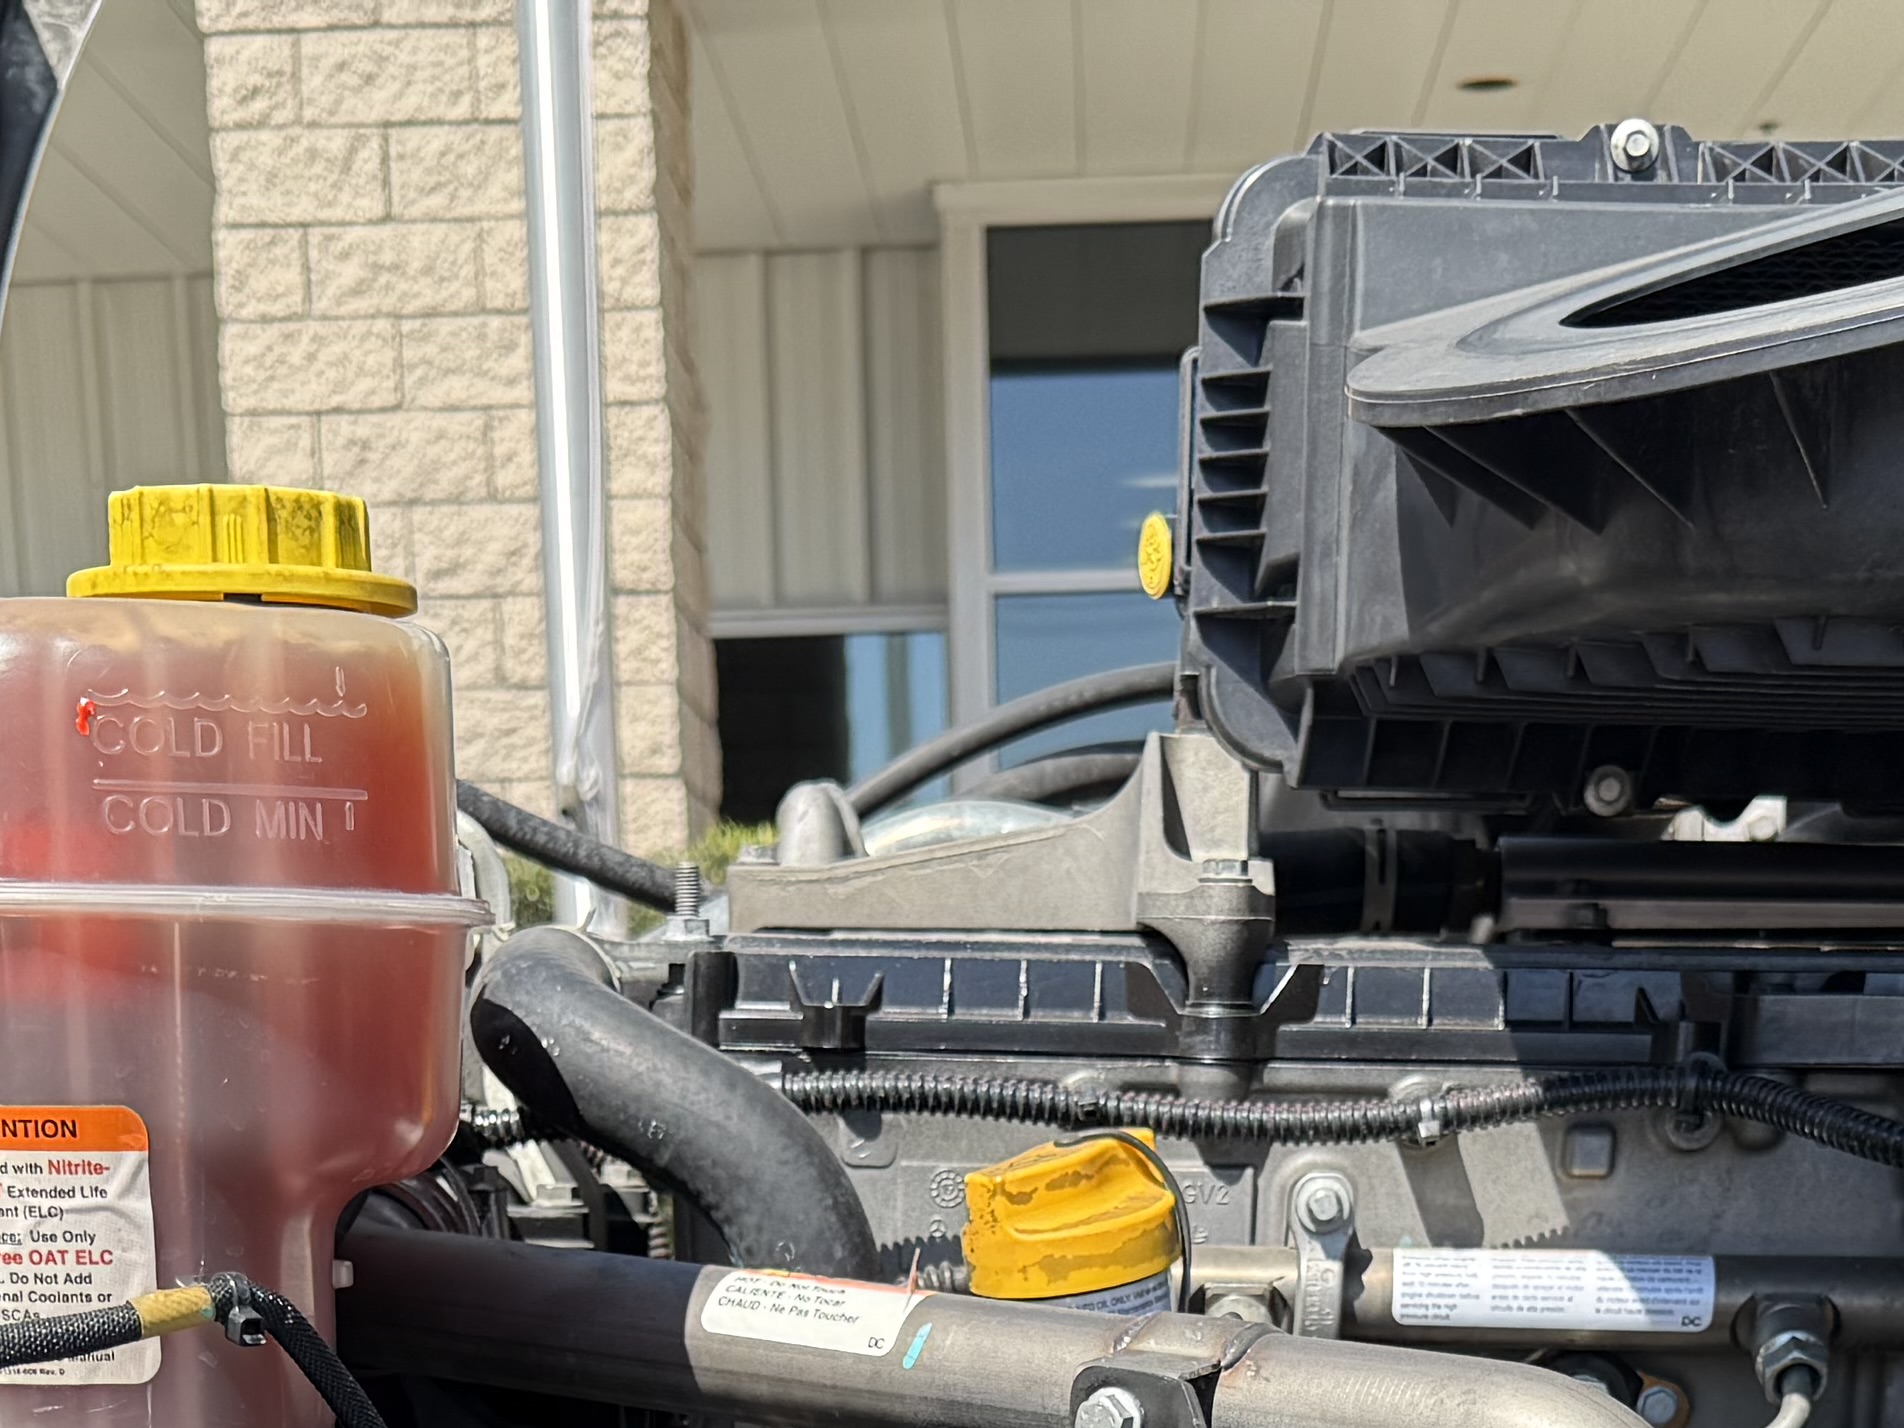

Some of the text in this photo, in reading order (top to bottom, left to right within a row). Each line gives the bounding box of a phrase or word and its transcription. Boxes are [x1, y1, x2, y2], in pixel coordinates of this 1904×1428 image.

[93, 715, 322, 763] COLD FILL
[101, 794, 324, 841] COLD MIN
[13, 1161, 43, 1175] with
[48, 1160, 110, 1175] Nitrite-
[7, 1185, 76, 1199] Extended
[80, 1185, 108, 1199] Life
[23, 1205, 64, 1221] (ELC)
[29, 1230, 57, 1243] Use
[62, 1230, 96, 1246] Only
[29, 1249, 70, 1265] OAT
[75, 1249, 113, 1265] ELC
[10, 1271, 28, 1285] Do
[34, 1271, 58, 1285] Not
[64, 1271, 92, 1285] Add
[28, 1290, 92, 1303] Coolants
[97, 1292, 112, 1303] or
[718, 1297, 761, 1311] CHAUD
[769, 1303, 785, 1315] Ne
[1681, 1315, 1701, 1327] DC
[868, 1336, 885, 1350] DC
